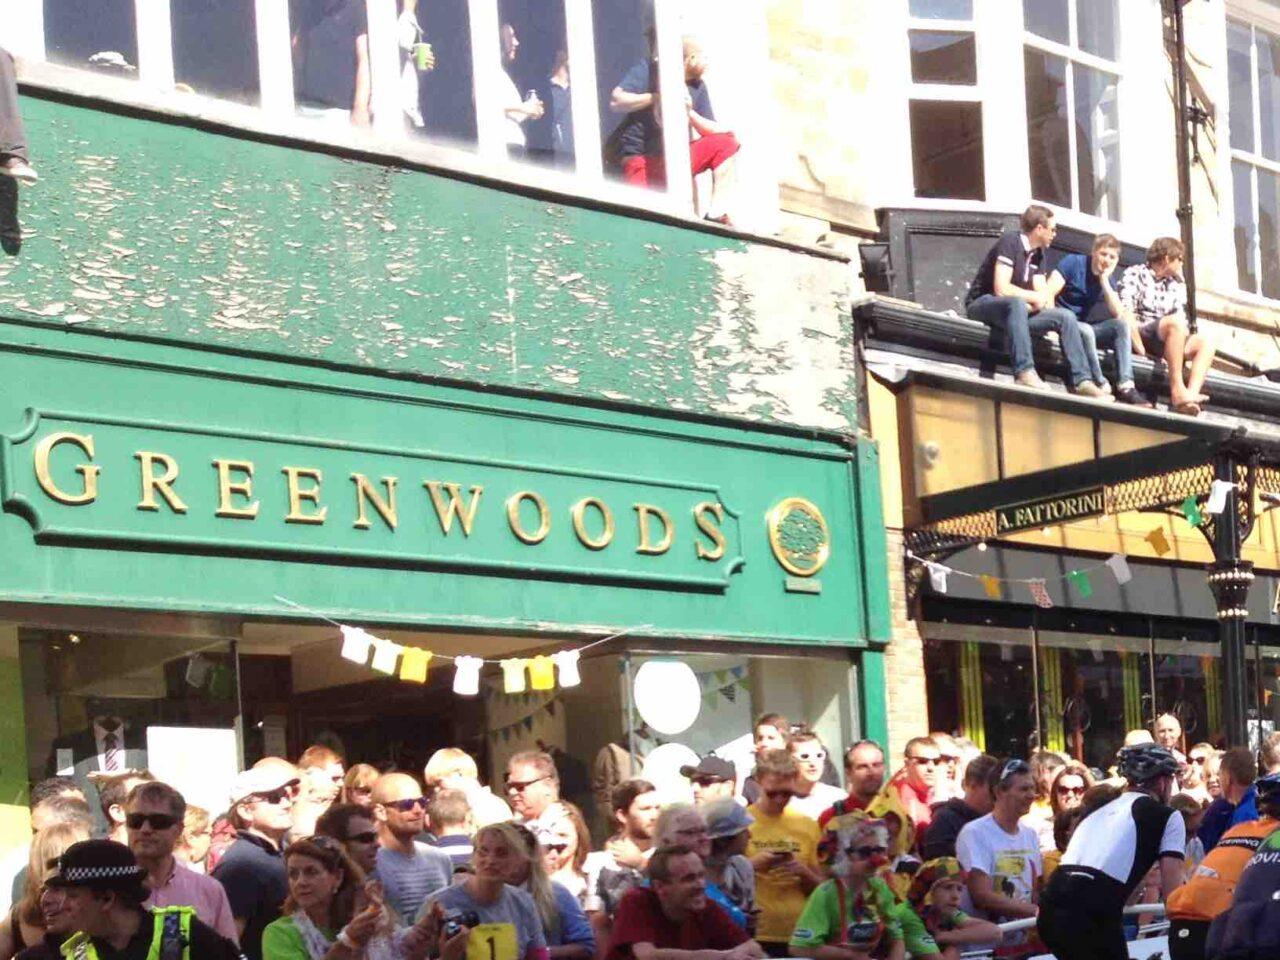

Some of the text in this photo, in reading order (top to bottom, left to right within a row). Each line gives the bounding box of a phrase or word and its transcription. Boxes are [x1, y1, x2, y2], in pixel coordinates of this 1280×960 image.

[32, 431, 728, 562] GREENWOODS
[997, 492, 1105, 531] A. FATTORINI
